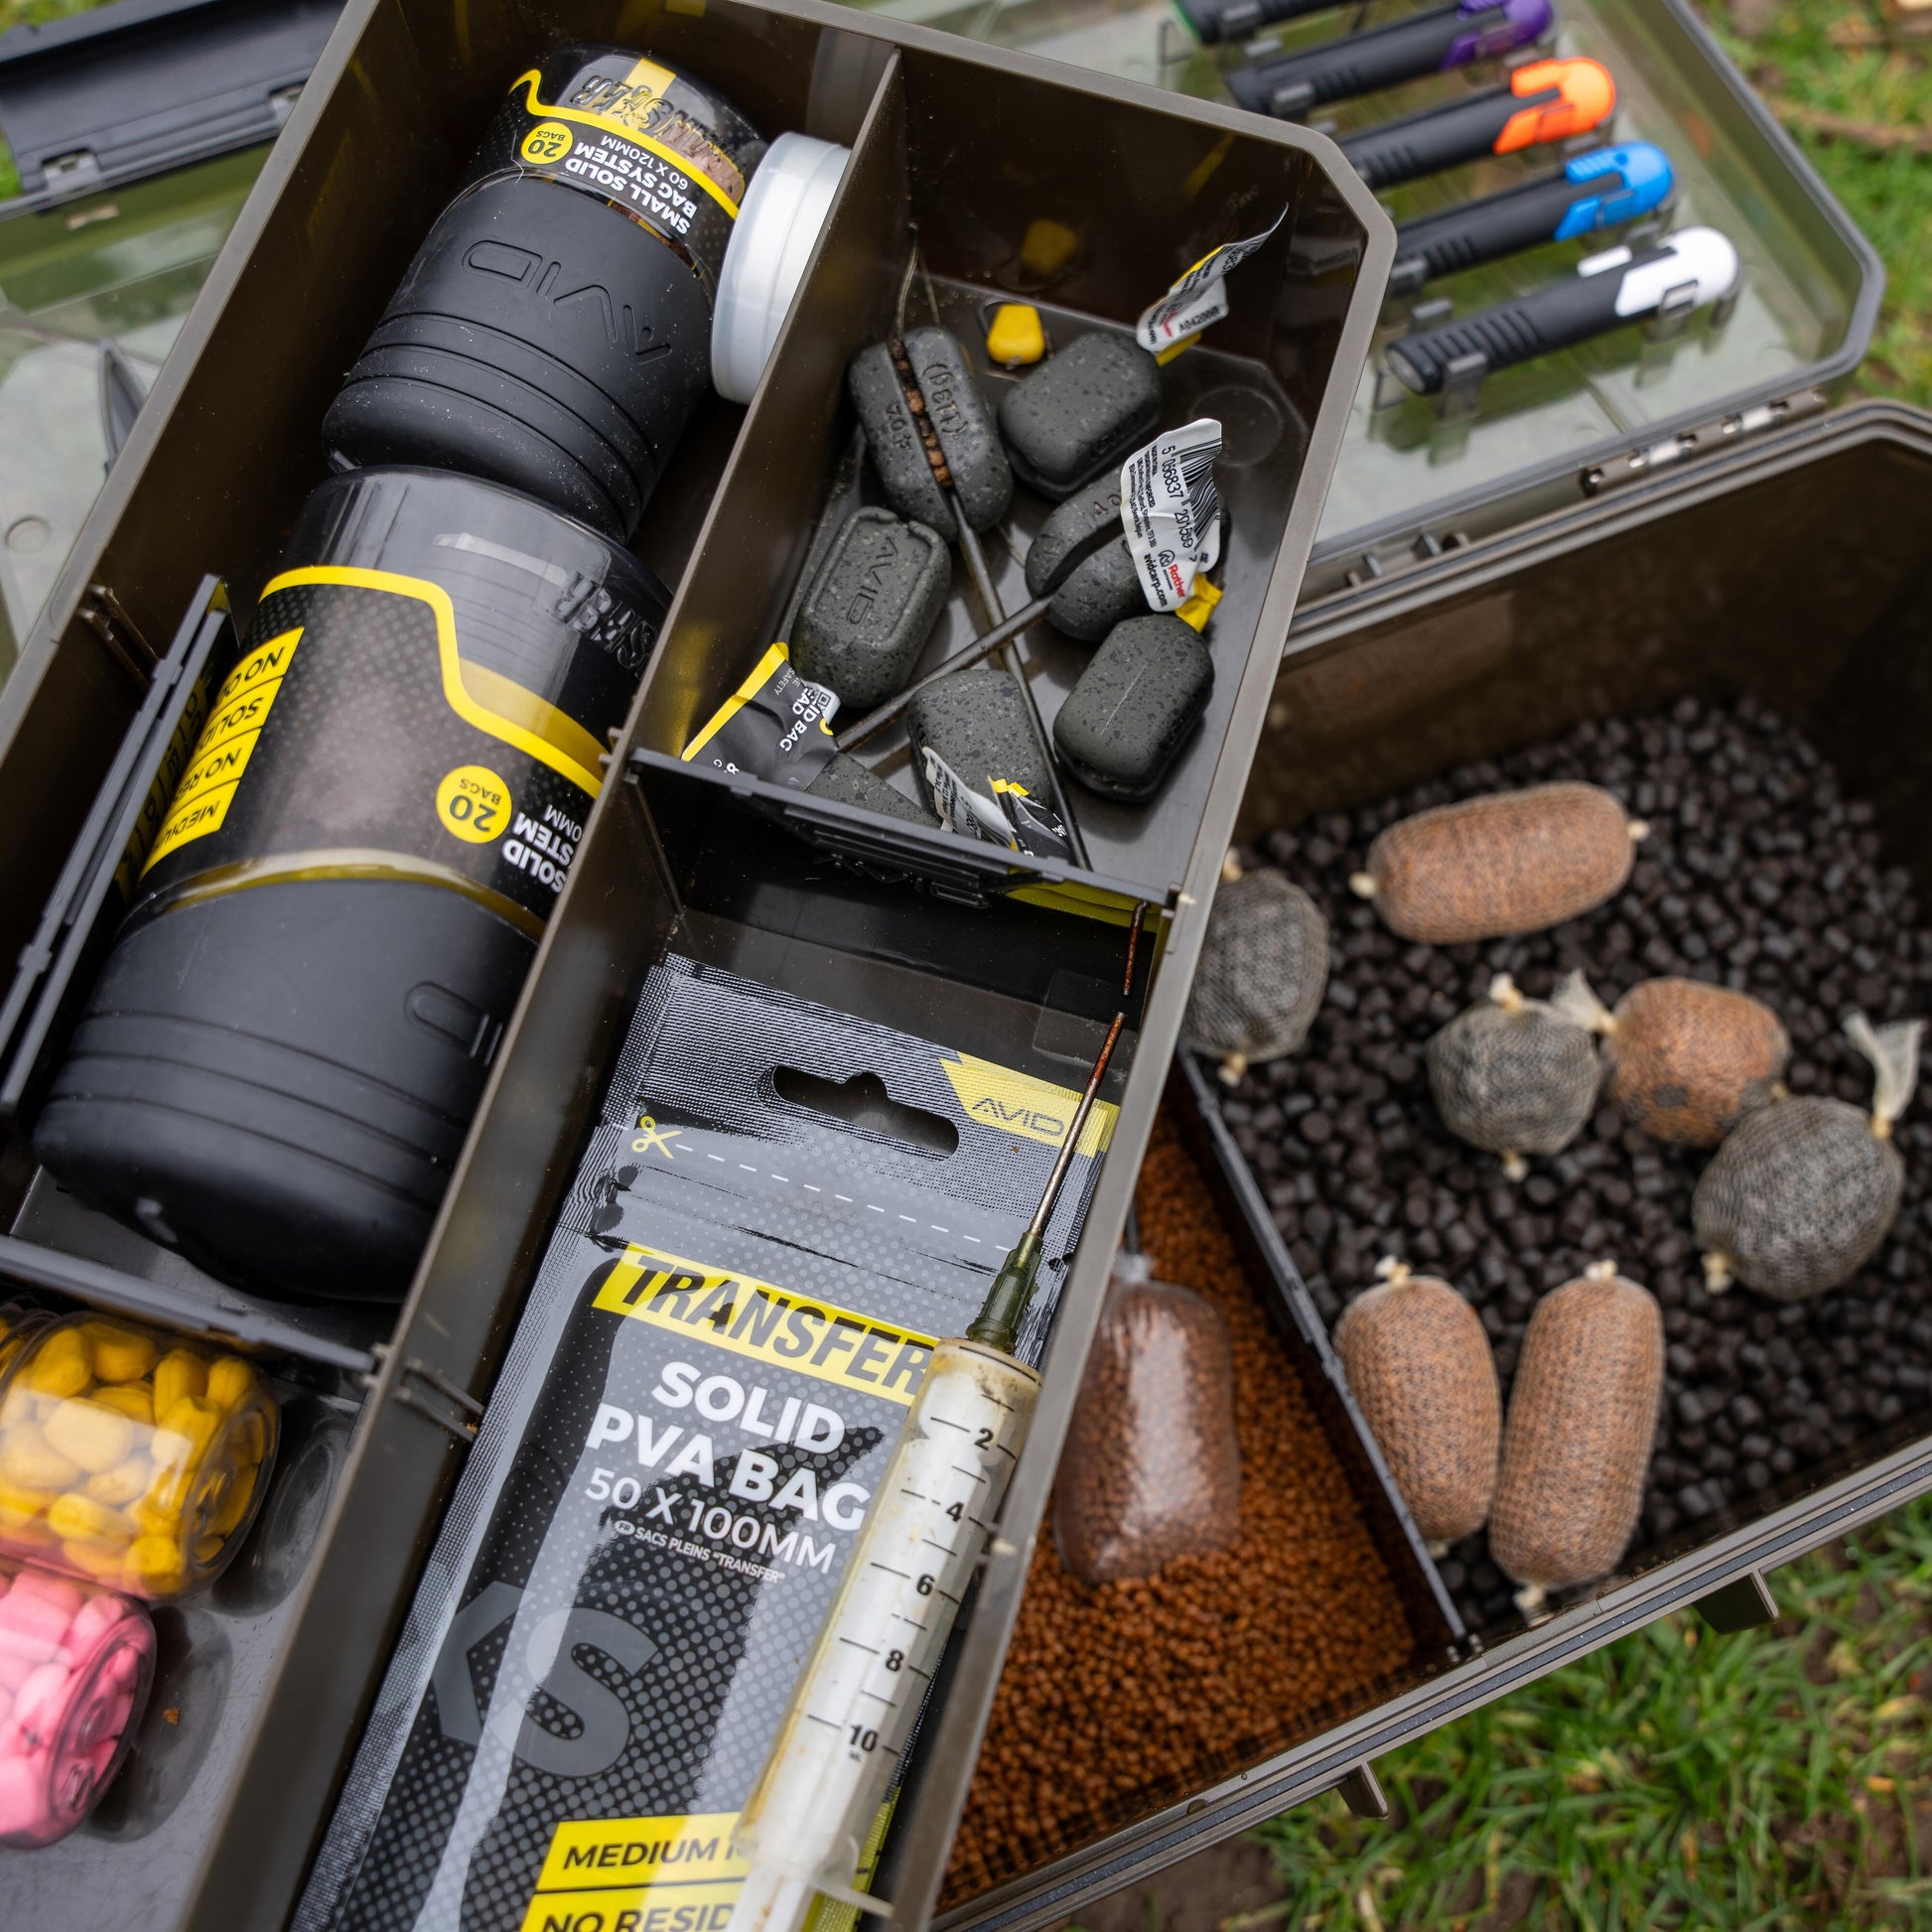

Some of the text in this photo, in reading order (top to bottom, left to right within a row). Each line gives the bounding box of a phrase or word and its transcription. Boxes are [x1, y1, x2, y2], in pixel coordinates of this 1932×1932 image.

[528, 139, 561, 157] 20
[536, 130, 565, 141] BAGS
[574, 142, 698, 219] BAG SYSTEM
[601, 135, 689, 191] 60 X 120MM
[565, 158, 691, 234] SMALL SOLID
[461, 239, 673, 365] AVID
[1162, 445, 1175, 455] 5
[846, 536, 898, 624] AVID
[1144, 553, 1169, 608] avidcarp.com
[244, 646, 286, 682] NO
[774, 667, 795, 695] SAFETY
[779, 720, 808, 752] BAG
[205, 748, 242, 779] NO
[460, 778, 501, 805] BAGS
[450, 794, 496, 832] 20
[543, 803, 583, 843] 0MM
[512, 811, 574, 867] STEM
[501, 838, 567, 894] SOLID
[972, 1097, 1065, 1137] AVID
[622, 1254, 936, 1396] TRANSFER
[651, 1361, 846, 1454] SOLID
[974, 1428, 995, 1450] 2
[585, 1402, 872, 1532] PVA BAG
[586, 1466, 837, 1575] 50 X 100MM
[945, 1501, 965, 1523] 4
[634, 1525, 668, 1549] SACS
[669, 1537, 711, 1562] PLEINS
[915, 1573, 936, 1596] 6
[885, 1649, 905, 1673] 8
[850, 1724, 881, 1753] 10
[562, 1837, 721, 1870] MEDIUM
[541, 1902, 737, 1932] NO RESID
